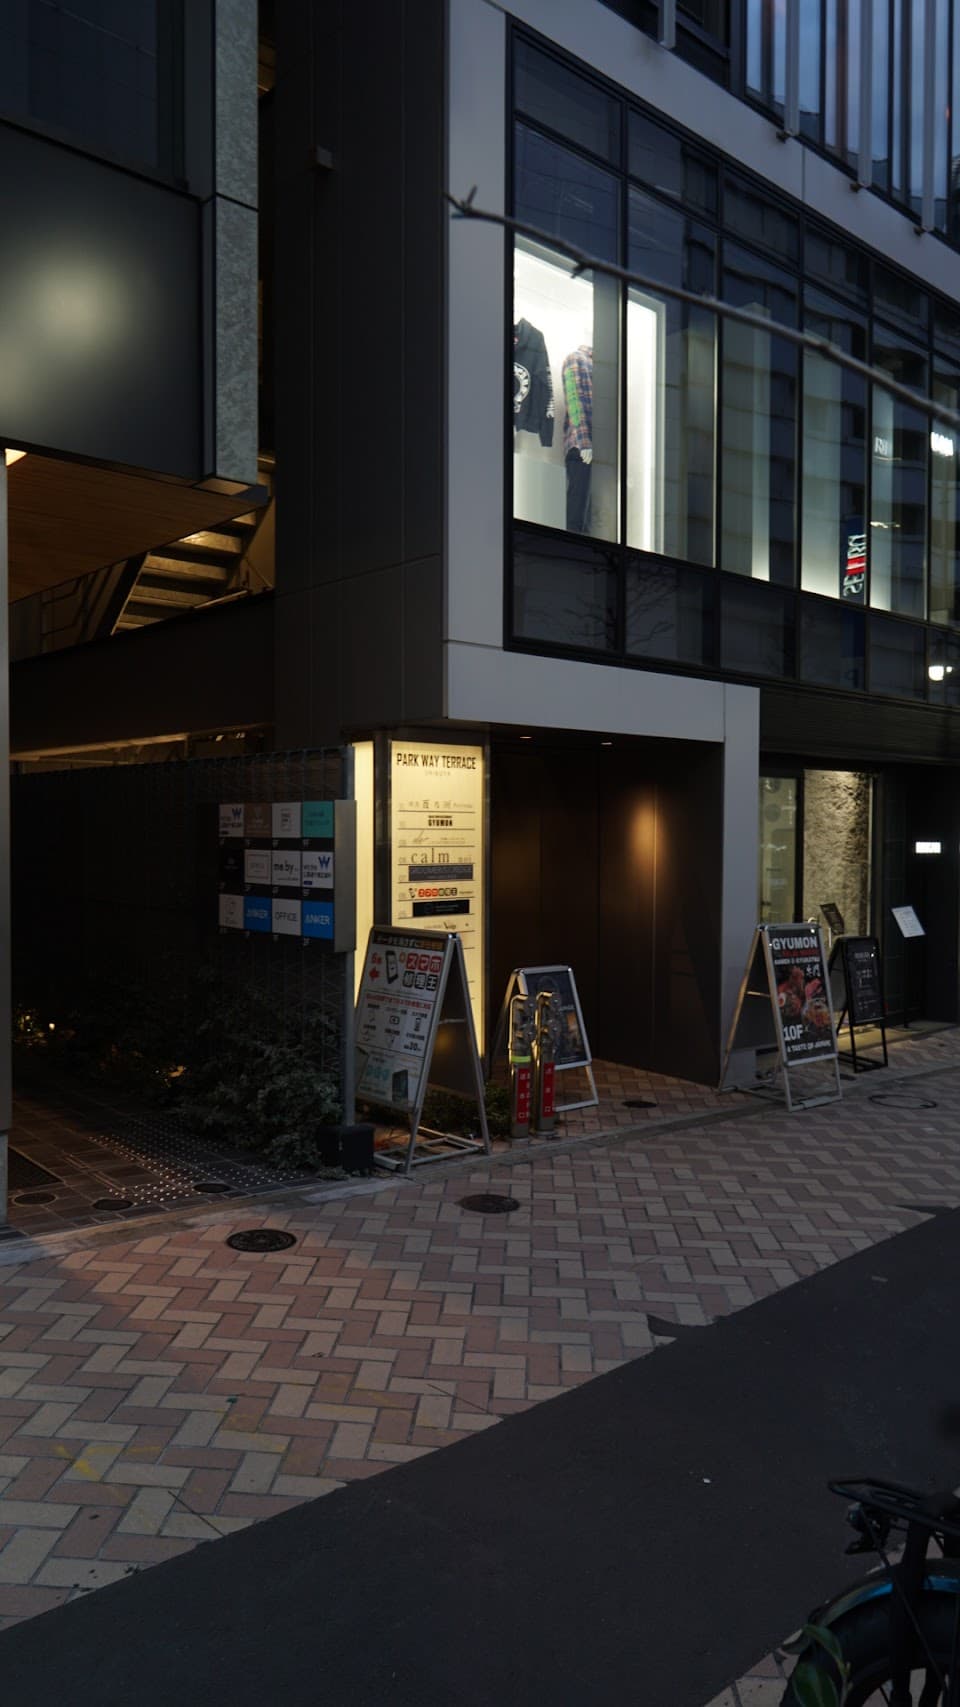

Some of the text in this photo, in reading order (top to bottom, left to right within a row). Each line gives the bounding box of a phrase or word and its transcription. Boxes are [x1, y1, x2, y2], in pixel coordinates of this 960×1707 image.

[396, 753, 477, 770] PARK WAY TERRACE
[411, 847, 449, 864] calm
[246, 909, 268, 920] ANKER
[274, 912, 298, 922] OFFICE
[305, 914, 330, 926] ANKER
[772, 936, 818, 950] GYUMON
[407, 953, 442, 973] スマホ
[783, 1024, 803, 1041] 10F
